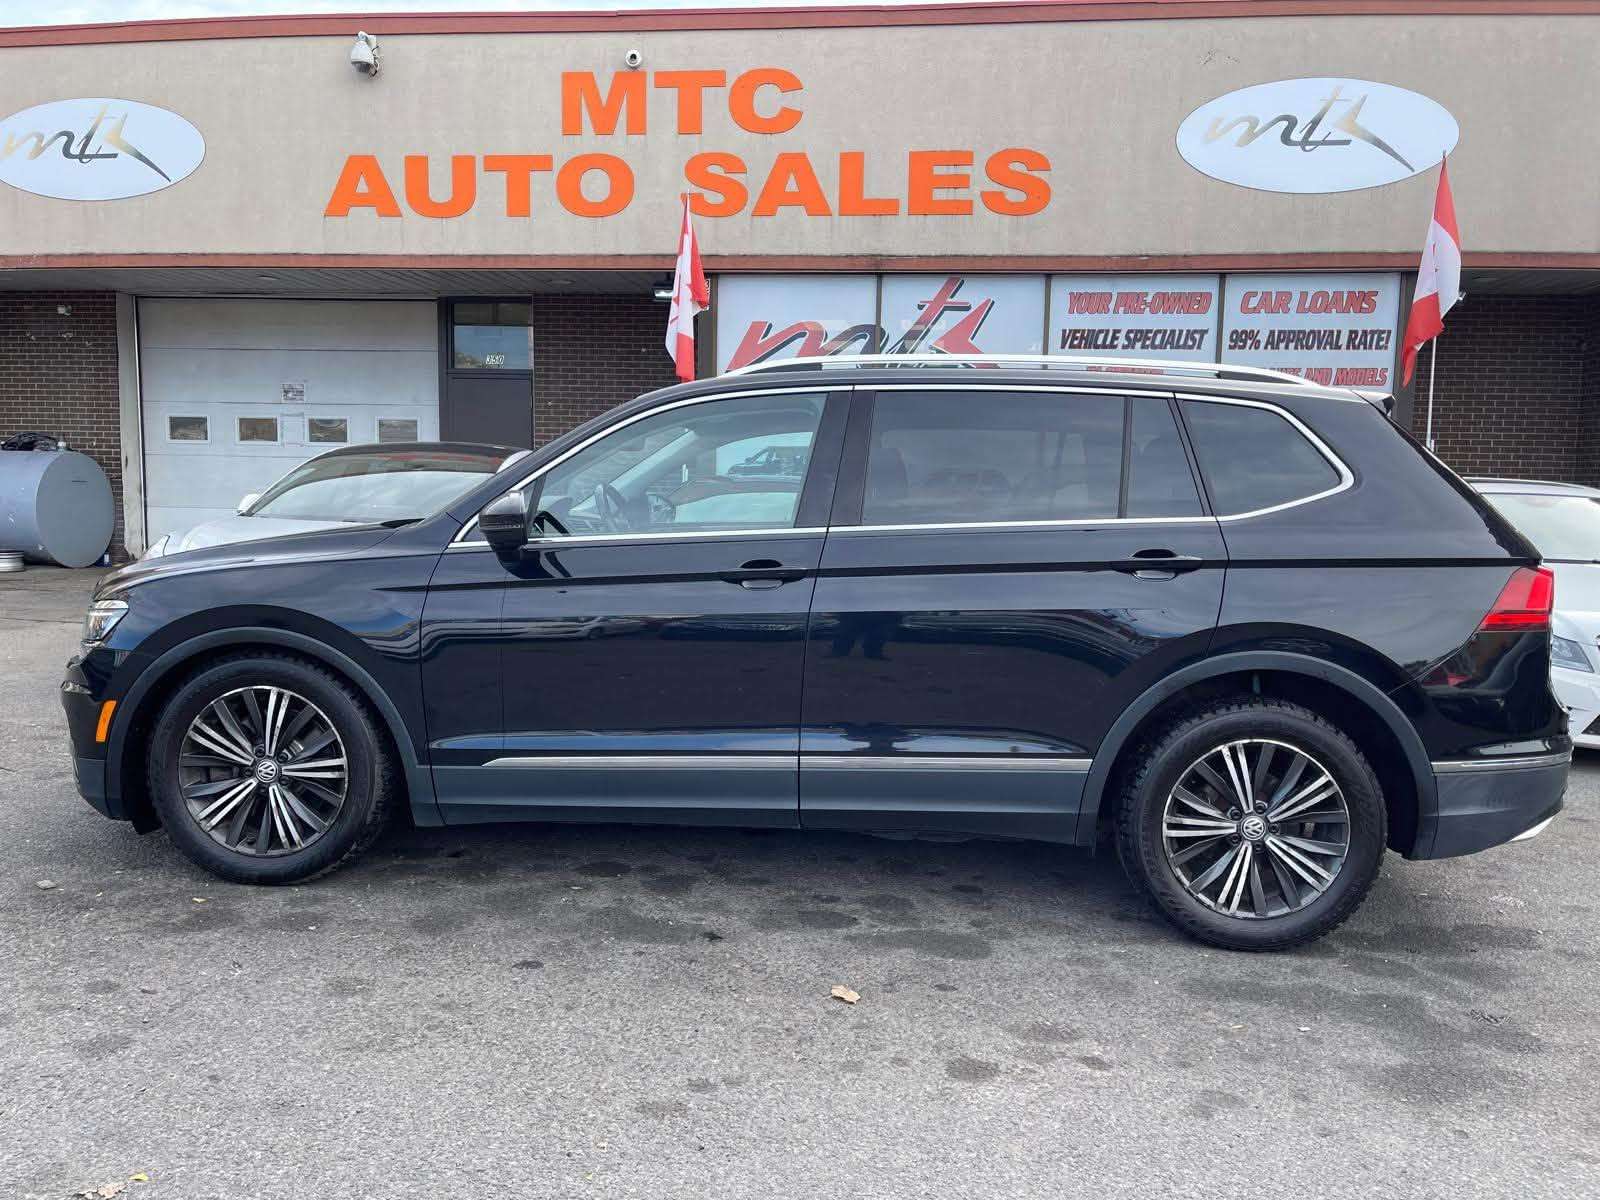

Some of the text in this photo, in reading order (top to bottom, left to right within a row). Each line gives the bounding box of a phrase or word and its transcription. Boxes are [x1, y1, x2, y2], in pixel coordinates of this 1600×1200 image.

[561, 68, 803, 135] MTC
[324, 148, 1052, 218] AUTO SALES
[1068, 291, 1212, 314] YOUR PRE-OWNED
[1240, 291, 1378, 314] CAR LOANS
[1061, 328, 1209, 350] VEHICLE SPECIALIST
[1228, 329, 1392, 350] 99% APPROVAL RATE!
[1304, 368, 1332, 386] AND
[1333, 368, 1388, 386] MODELS
